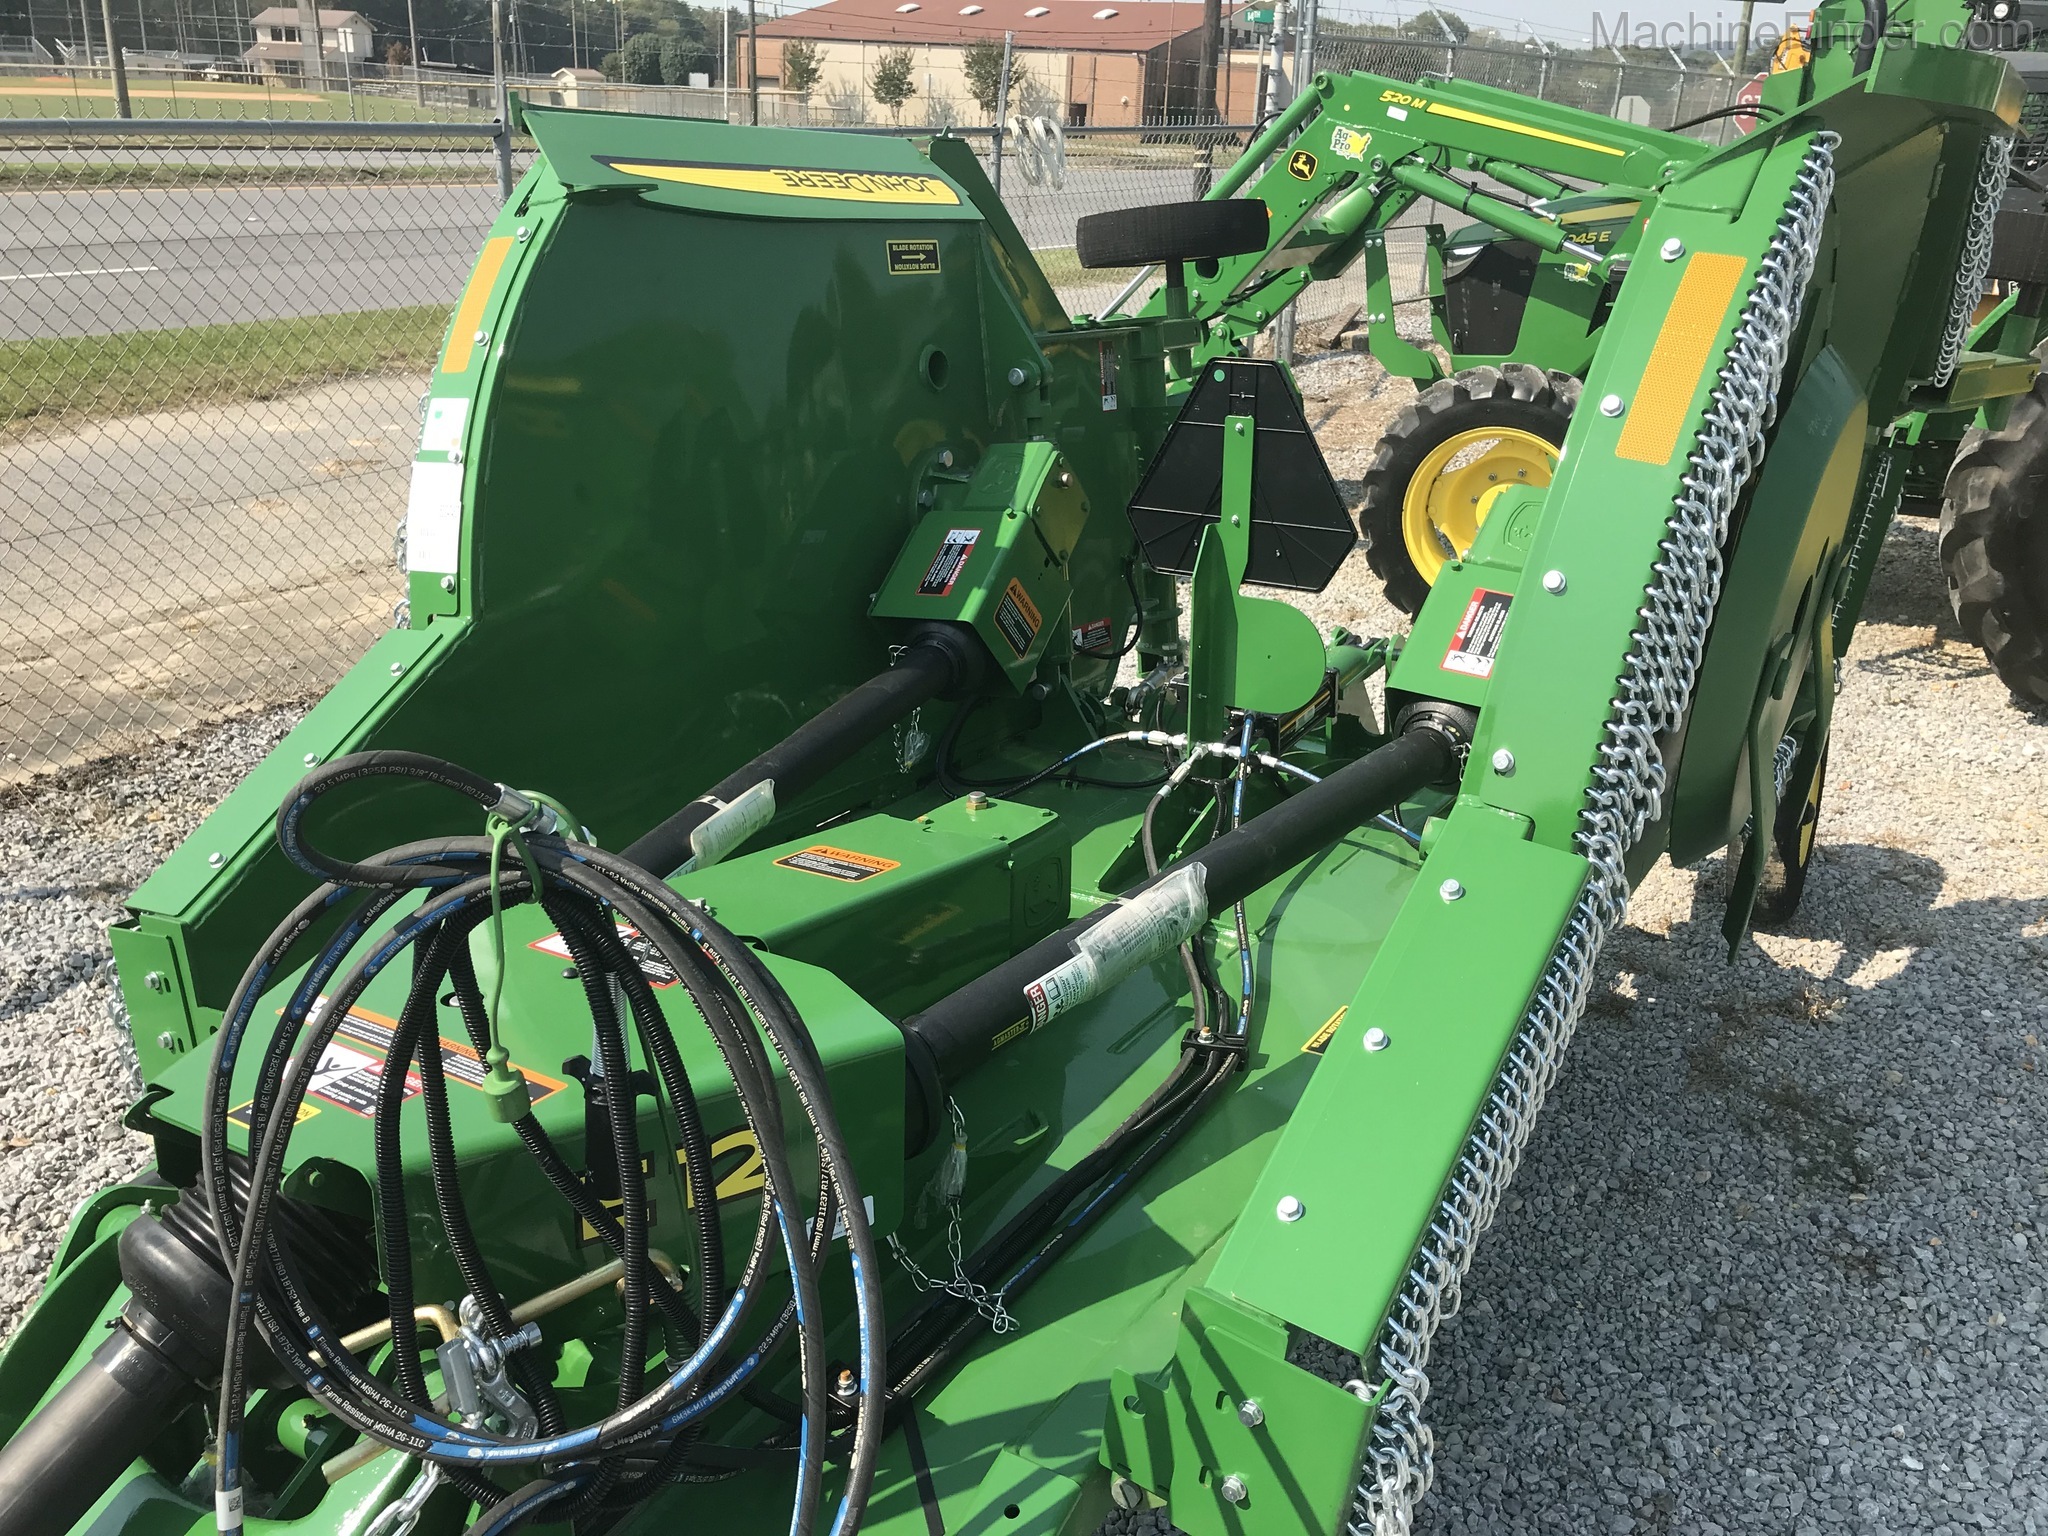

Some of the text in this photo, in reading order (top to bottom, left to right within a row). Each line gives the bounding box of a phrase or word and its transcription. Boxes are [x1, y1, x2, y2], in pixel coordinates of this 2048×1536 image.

[1332, 139, 1351, 151] Pro
[774, 172, 937, 196] JOHN DEERE
[894, 263, 918, 271] ROTATION
[947, 560, 966, 586] DANGER
[1014, 591, 1041, 628] WARNING
[1460, 600, 1480, 631] DANGER
[314, 778, 335, 794] 22.5
[335, 771, 357, 786] MPa
[461, 783, 476, 796] ISO
[829, 850, 895, 869] WARNING
[619, 876, 641, 893] MSHA
[640, 888, 672, 916] Resistant
[706, 946, 723, 966] Type
[350, 978, 367, 997] 22.5
[337, 994, 352, 1012] MPa
[281, 1020, 295, 1039] 22.5
[1310, 1030, 1332, 1048] BLADE
[274, 1036, 289, 1054] MPa
[284, 1103, 296, 1117] ISO
[276, 1118, 291, 1145] 11237
[271, 1143, 283, 1161] R17
[265, 1166, 277, 1182] SAE
[820, 1174, 829, 1191] R17
[818, 1191, 829, 1217] 11237
[223, 1211, 234, 1227] ISO
[254, 1218, 265, 1233] ISO
[815, 1217, 826, 1231] ISO
[274, 1261, 287, 1276] ISO
[280, 1275, 299, 1300] 18752
[292, 1299, 307, 1320] Type
[680, 1345, 711, 1379] 6M3K-MTF
[708, 1305, 736, 1347] MegaTuff™
[742, 1270, 754, 1287] 22.5
[749, 1251, 760, 1271] MPa
[317, 1335, 335, 1359] Flame
[332, 1356, 361, 1385] Resistant
[671, 1396, 709, 1424] 6M3K-MTF
[706, 1367, 744, 1402] MegaTuff™
[757, 1335, 774, 1355] 22.5
[771, 1321, 785, 1339] MPa
[267, 1318, 281, 1334] ISO
[274, 1330, 296, 1354] 18752
[290, 1352, 306, 1370] Type
[321, 1384, 342, 1404] Flame
[341, 1400, 376, 1428] Resistant
[372, 1420, 395, 1438] MSHA
[393, 1430, 426, 1449] 2G-11C
[360, 1381, 381, 1401] MSHA
[378, 1396, 408, 1419] 2G-11C
